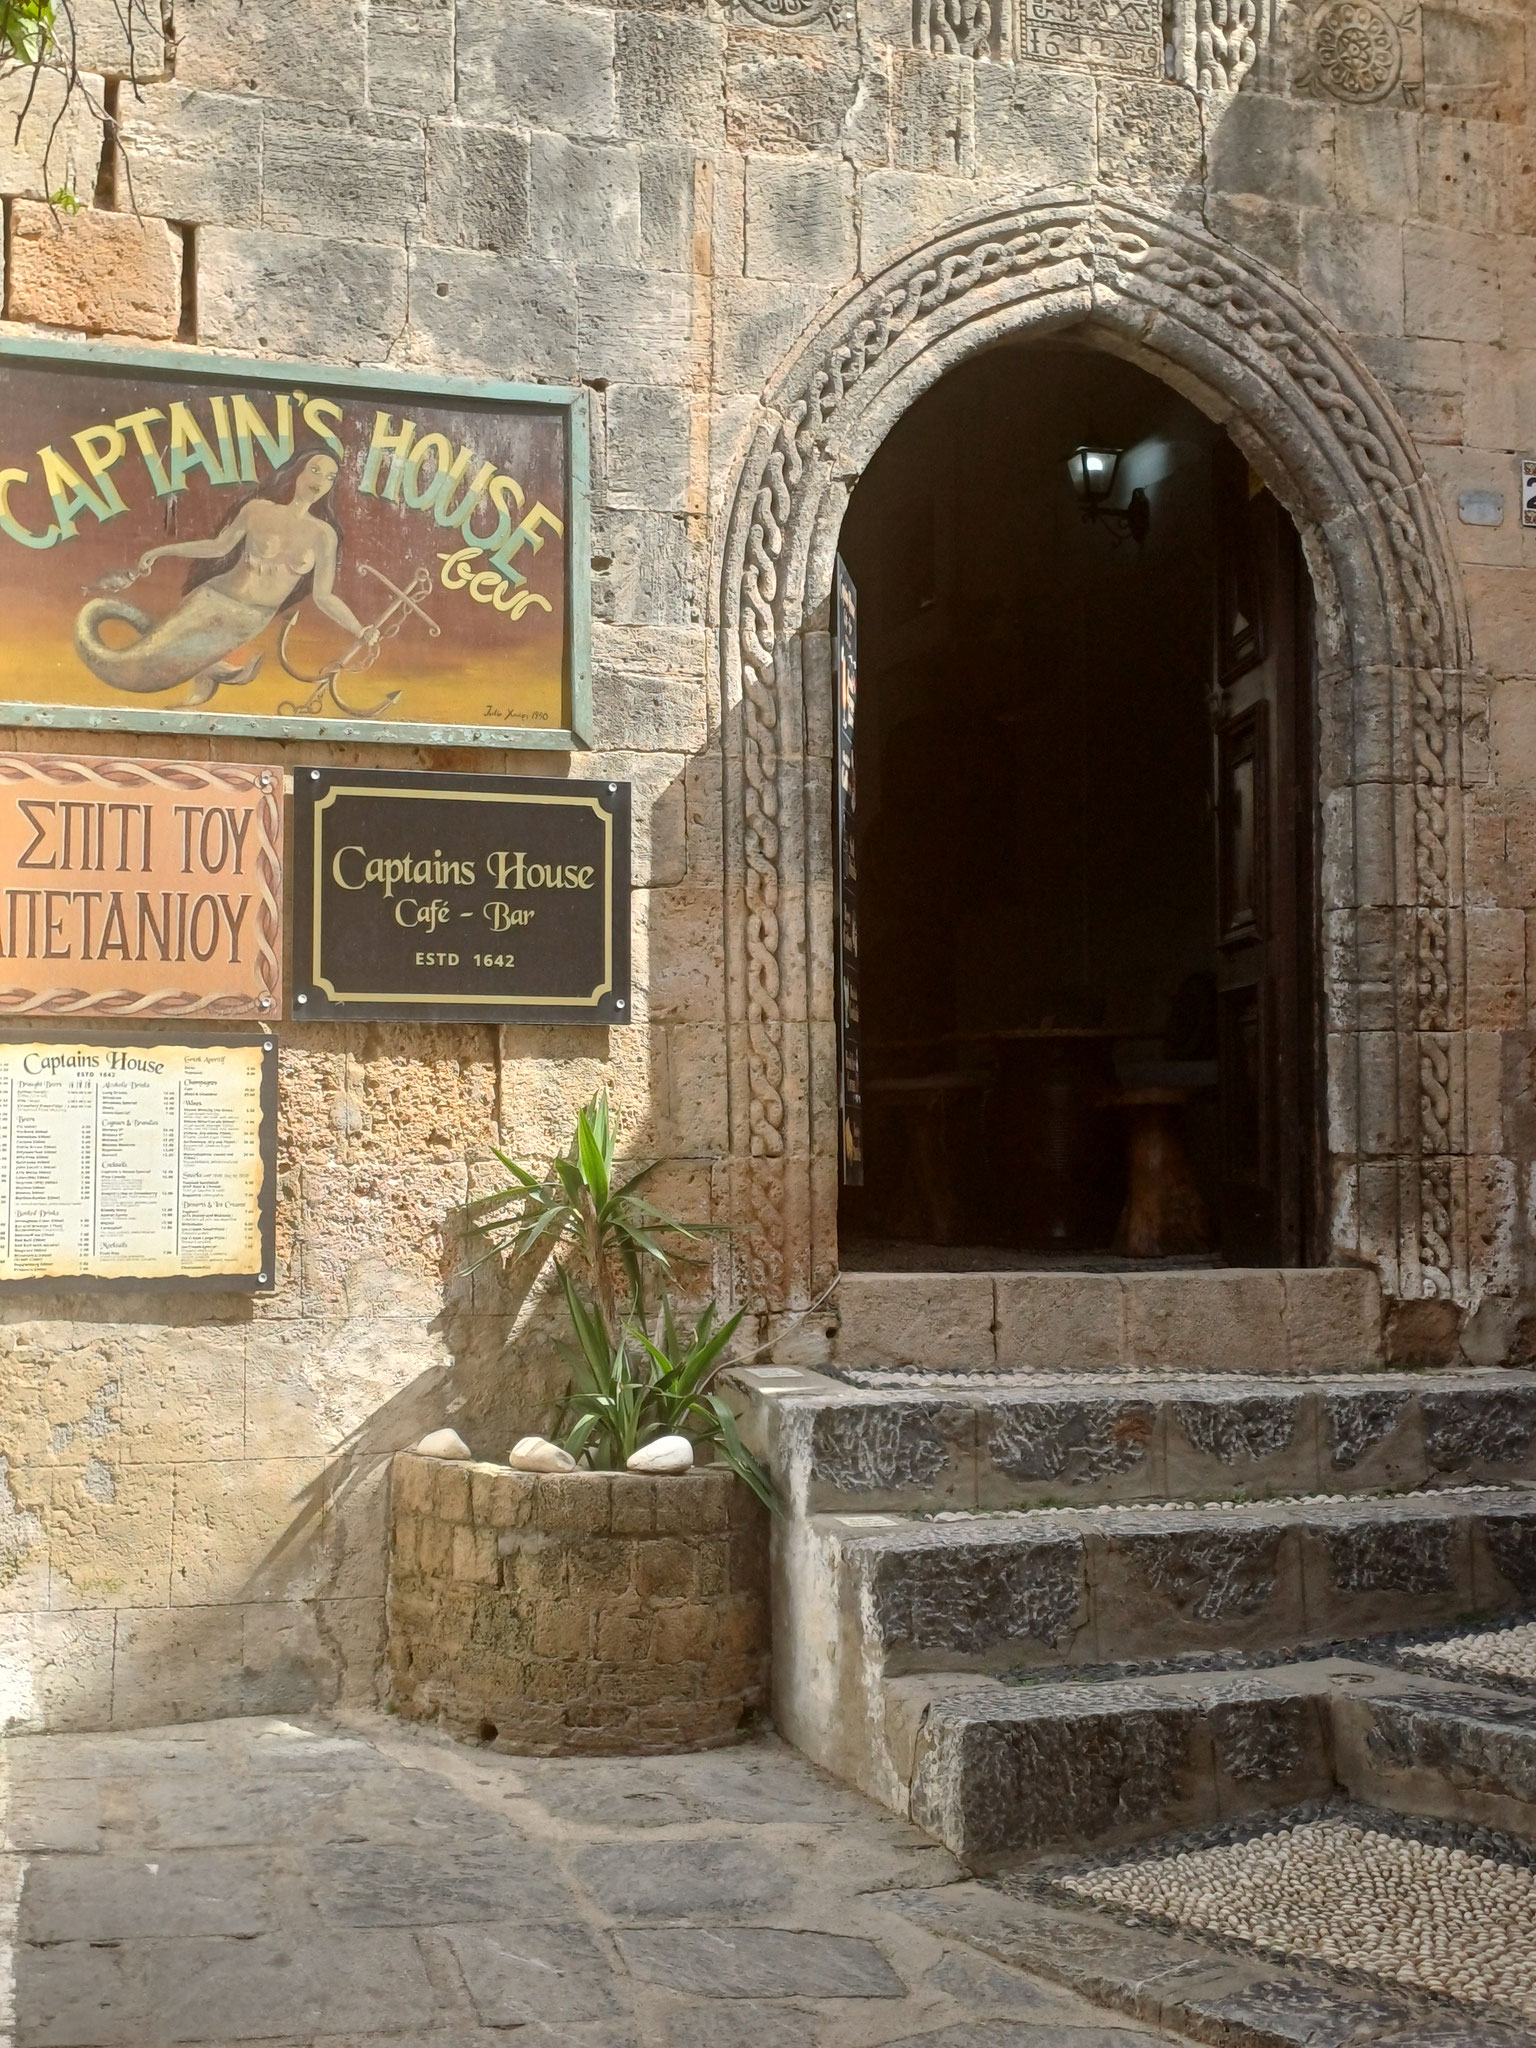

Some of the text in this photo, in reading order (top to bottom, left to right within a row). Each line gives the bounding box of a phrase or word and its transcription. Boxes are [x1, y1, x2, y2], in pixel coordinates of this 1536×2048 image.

[0, 389, 564, 589] CAPTAIN'S HOUSE
[16, 799, 255, 874] ΣΠΙΤΙ ΤΟΥ
[332, 846, 595, 899] Captains House
[0, 888, 253, 964] ΠΕΤΑΝΙΟΥ
[395, 898, 451, 933] Café
[483, 901, 535, 931] Bar
[415, 952, 515, 968] ESTD 1642
[24, 1051, 99, 1075] Captains
[106, 1051, 164, 1074] House
